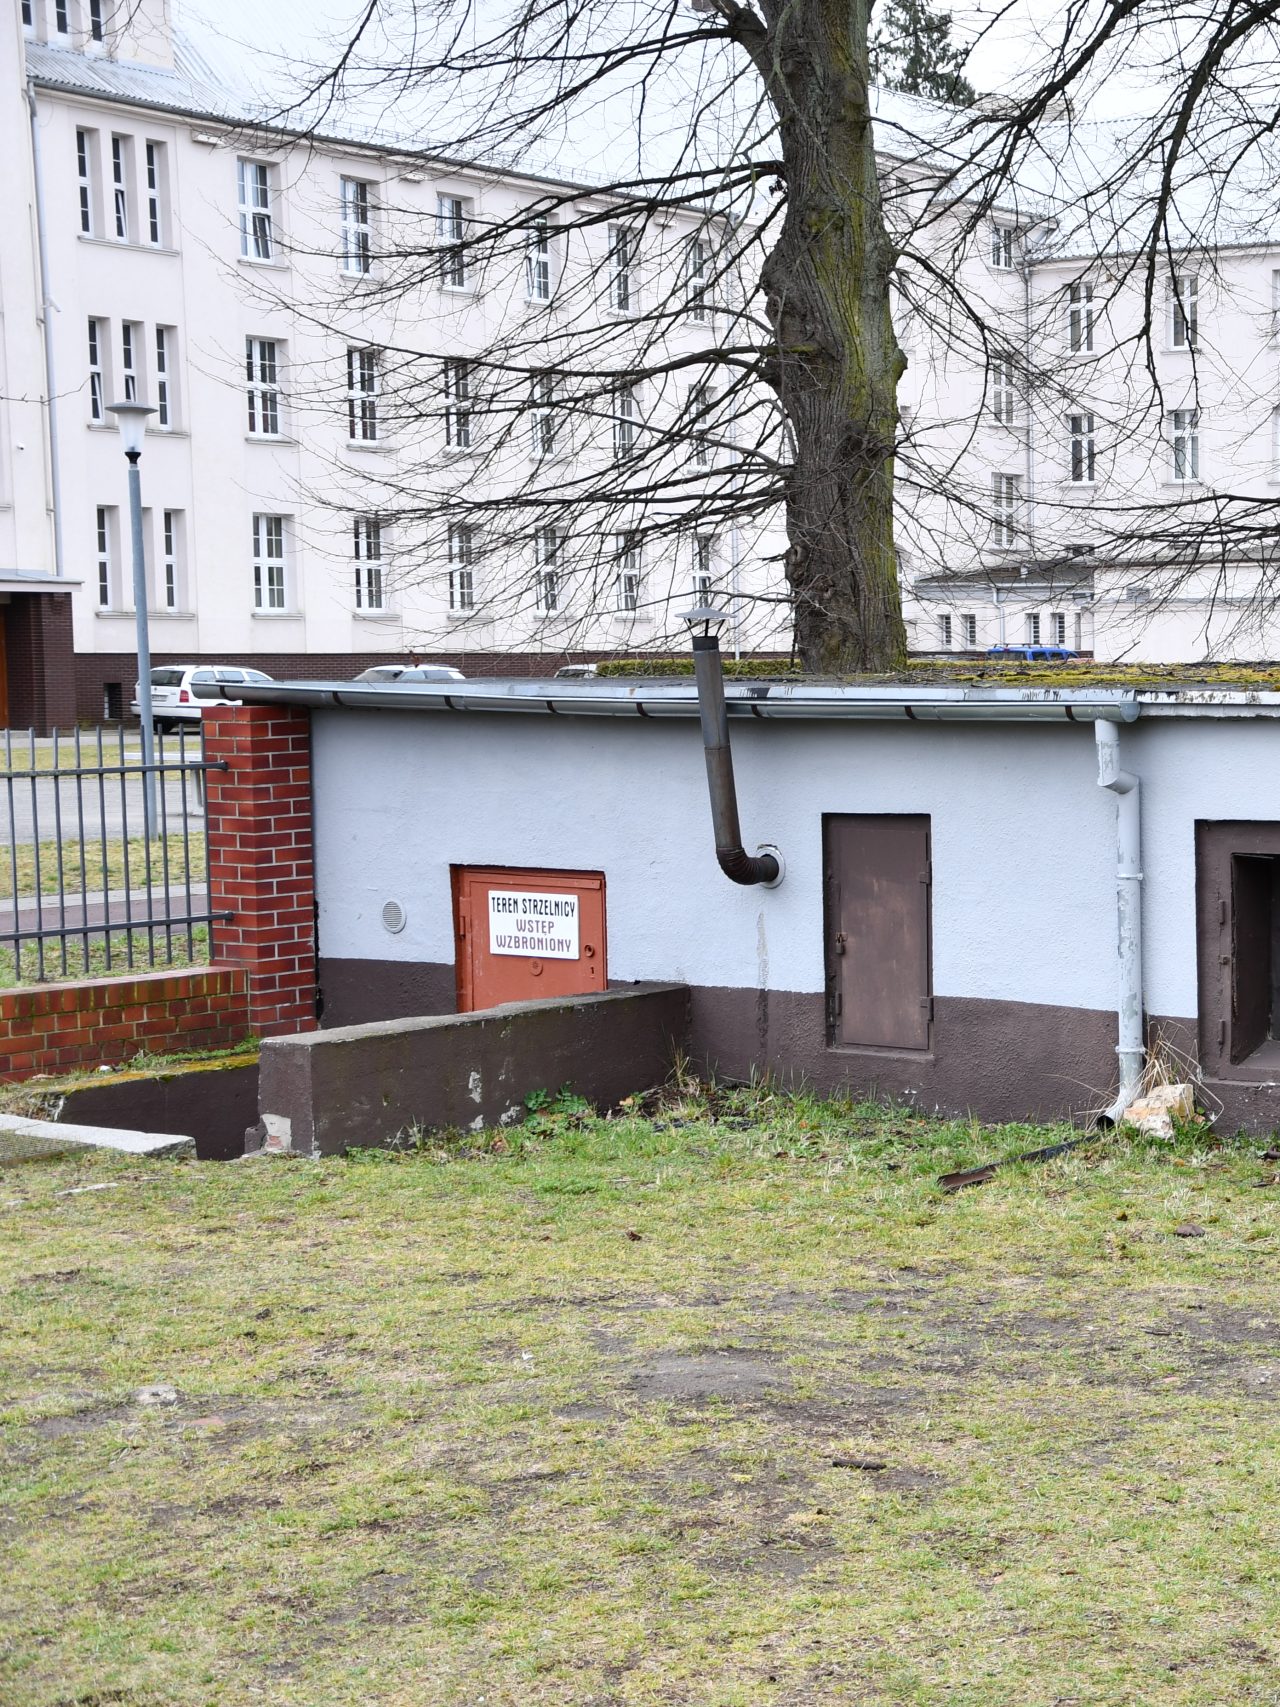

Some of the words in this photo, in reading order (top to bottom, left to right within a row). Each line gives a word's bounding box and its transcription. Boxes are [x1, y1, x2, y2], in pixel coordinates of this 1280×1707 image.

[491, 896, 518, 913] TEREN
[522, 898, 575, 917] STRZELNICY
[516, 918, 555, 936] WSTĘP
[496, 934, 571, 952] WZBRONIONY
